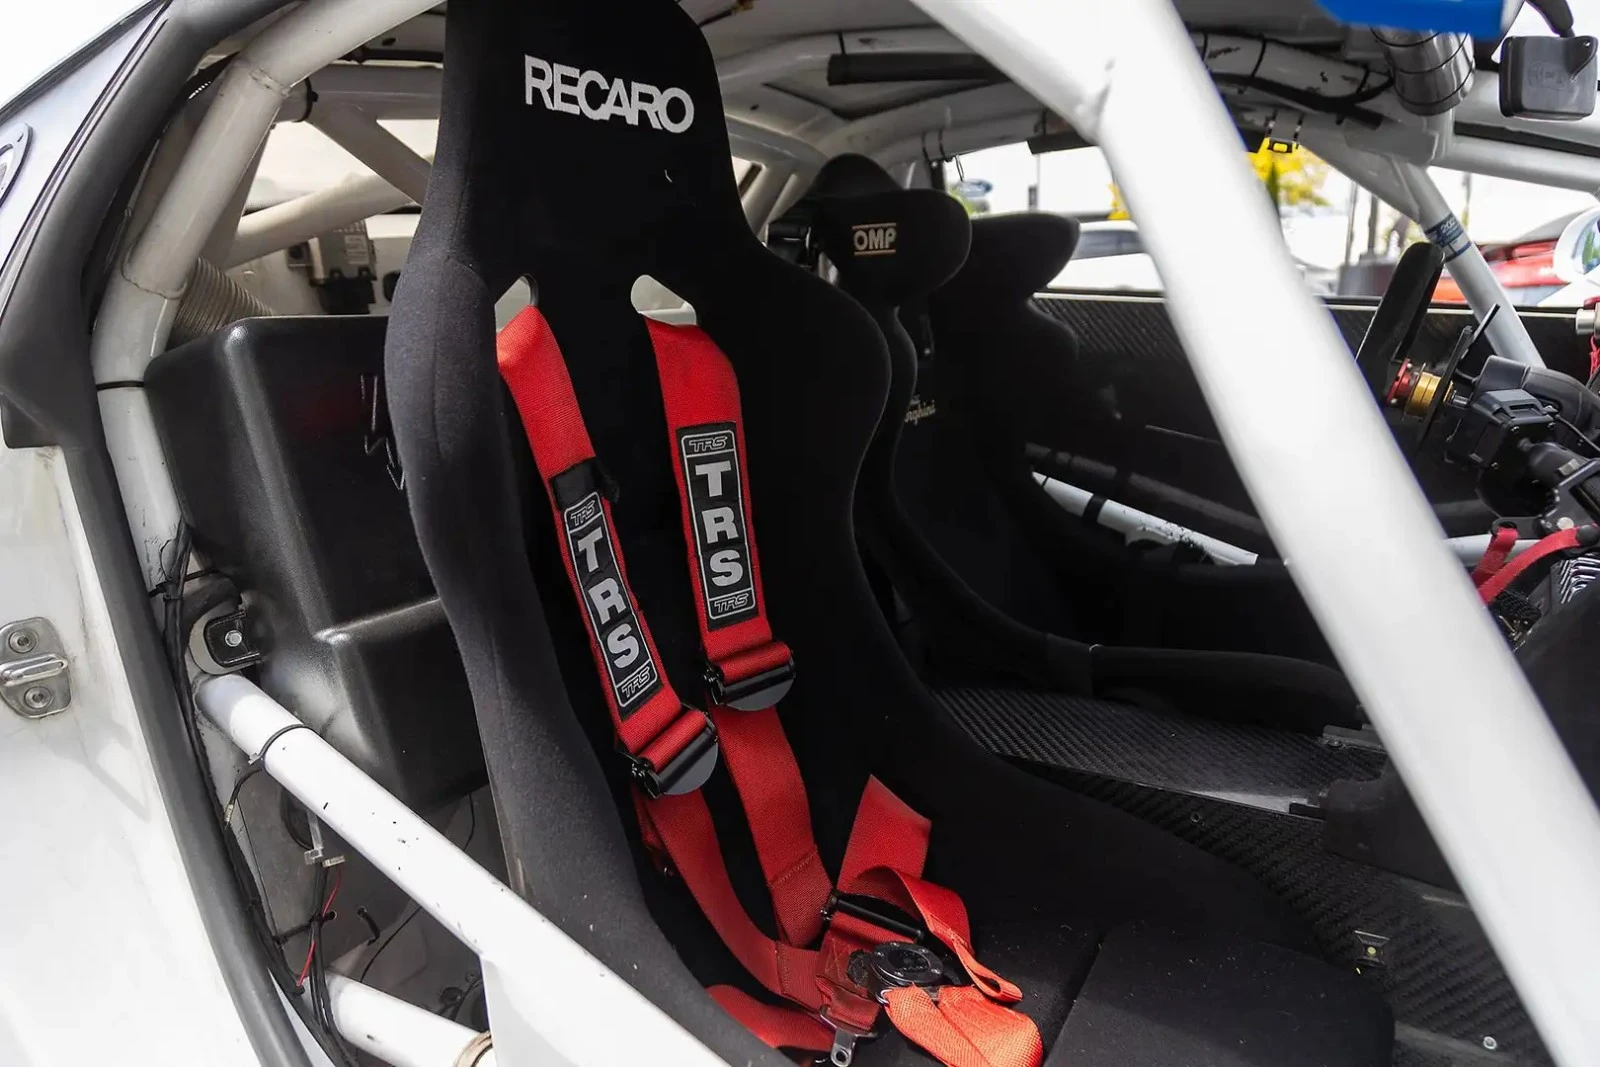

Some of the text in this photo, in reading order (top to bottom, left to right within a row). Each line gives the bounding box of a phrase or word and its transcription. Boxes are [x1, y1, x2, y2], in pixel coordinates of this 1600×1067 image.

[524, 54, 695, 134] RECARO
[853, 227, 897, 251] OMP
[688, 435, 729, 453] TRS
[570, 500, 596, 527] TRS
[695, 460, 744, 587] TRS
[577, 526, 640, 669] TRS
[714, 592, 749, 613] TRS
[621, 666, 650, 698] TRS
